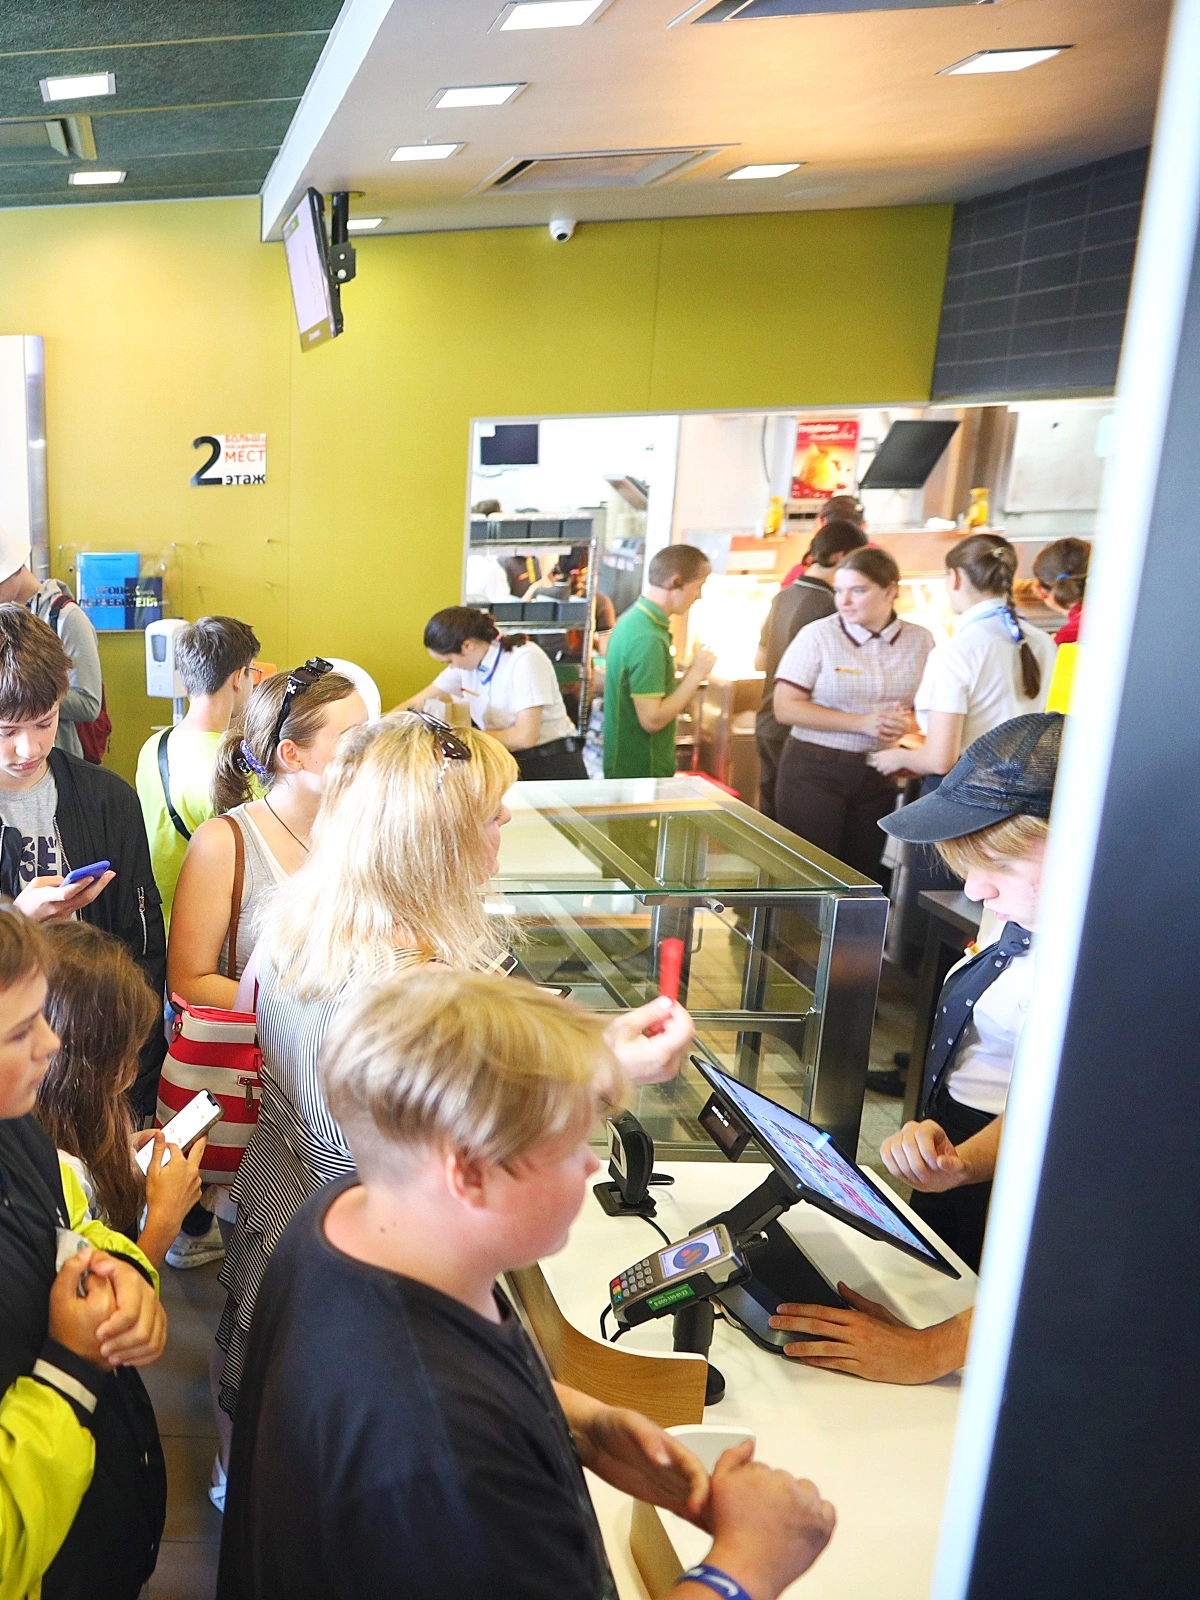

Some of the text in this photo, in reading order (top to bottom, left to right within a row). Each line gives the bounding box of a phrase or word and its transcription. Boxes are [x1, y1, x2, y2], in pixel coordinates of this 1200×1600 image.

[190, 436, 266, 486] 2 этаж
[225, 450, 266, 463] МЕСТ
